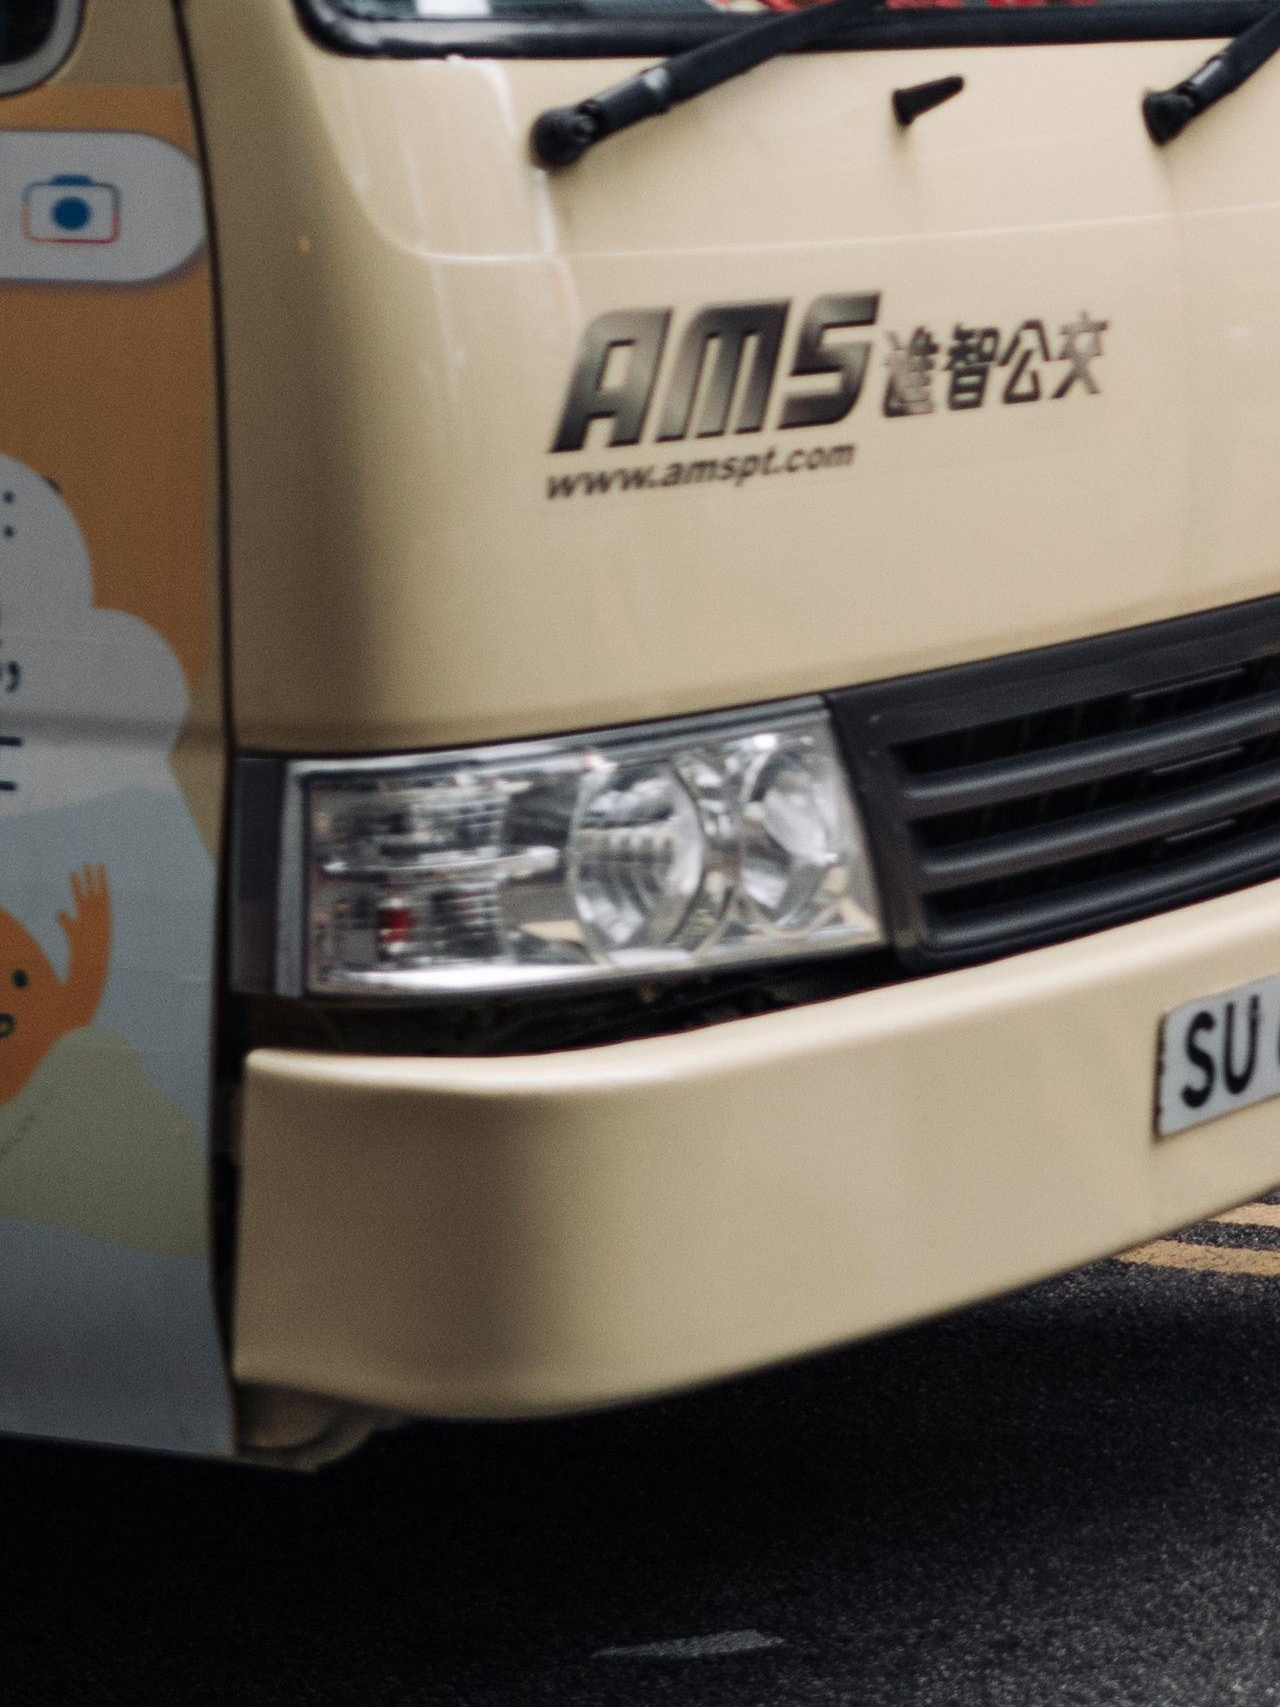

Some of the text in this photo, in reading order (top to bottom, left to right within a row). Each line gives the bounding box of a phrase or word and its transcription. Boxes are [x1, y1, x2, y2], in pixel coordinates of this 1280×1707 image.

[546, 290, 882, 454] AMS
[545, 442, 857, 501] www.amspt.com
[1181, 994, 1260, 1109] SU
